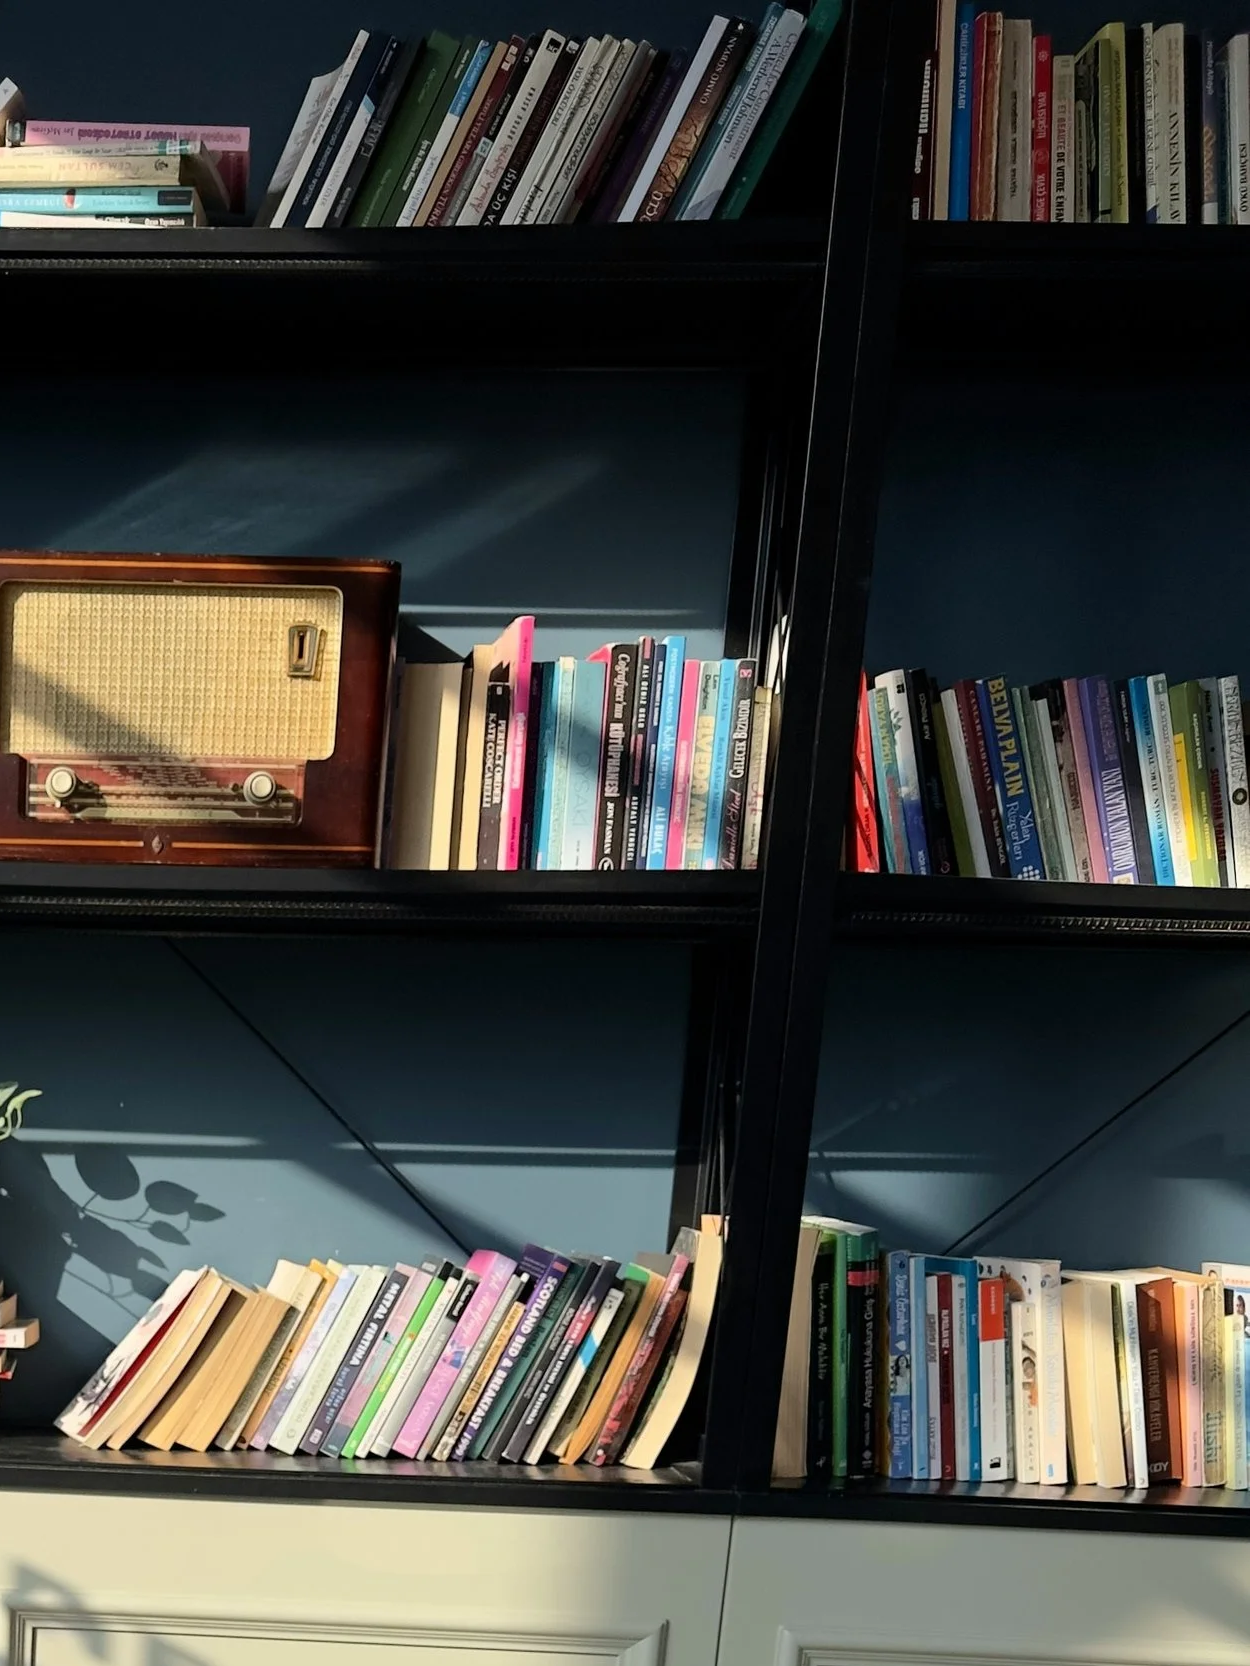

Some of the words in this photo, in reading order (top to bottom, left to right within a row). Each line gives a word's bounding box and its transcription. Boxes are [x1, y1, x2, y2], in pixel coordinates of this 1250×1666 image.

[757, 14, 778, 46] SUSANNA
[743, 44, 763, 72] TAMARO
[770, 30, 799, 74] Created
[762, 71, 778, 90] for
[1036, 91, 1047, 108] VAR
[722, 98, 753, 145] Johnson
[727, 87, 771, 161] Commitment
[1056, 151, 1065, 163] DE
[1236, 142, 1249, 183] BAHÇESİ
[490, 191, 507, 211] ÜÇ
[499, 167, 519, 192] KİŞİ
[1055, 165, 1065, 193] VOTRE
[1237, 185, 1247, 212] ÖYKÜ
[667, 647, 679, 694] POSTMODERN
[700, 673, 711, 711] Deighton
[986, 676, 1015, 739] BELVA
[485, 712, 499, 741] KATE
[491, 718, 512, 767] PERFECT
[967, 689, 983, 736] CANLARI
[976, 739, 993, 792] PAHASINA
[602, 721, 626, 798] KÜTÜPHANESİ
[691, 714, 715, 795] ELVEDA
[727, 738, 747, 779] GELECEK
[998, 737, 1025, 797] PLAIN
[479, 742, 497, 808] COSCARELLI
[489, 766, 505, 804] ORDER
[1100, 766, 1123, 789] YANI
[605, 800, 615, 818] JON
[655, 805, 666, 822] ALİ
[1102, 787, 1127, 818] YALAN
[602, 818, 614, 854] FASMAN
[371, 1280, 401, 1322] METAL
[518, 1273, 559, 1336] SCOTLAND
[864, 1298, 875, 1320] Giriş
[347, 1320, 380, 1369] FIRTINA
[500, 1356, 515, 1371] &
[506, 1333, 527, 1359] BED
[863, 1321, 874, 1367] Hukukuna
[466, 1367, 509, 1432] BREAKFAST
[862, 1368, 874, 1408] Anayasa
[452, 1430, 473, 1457] 1999
